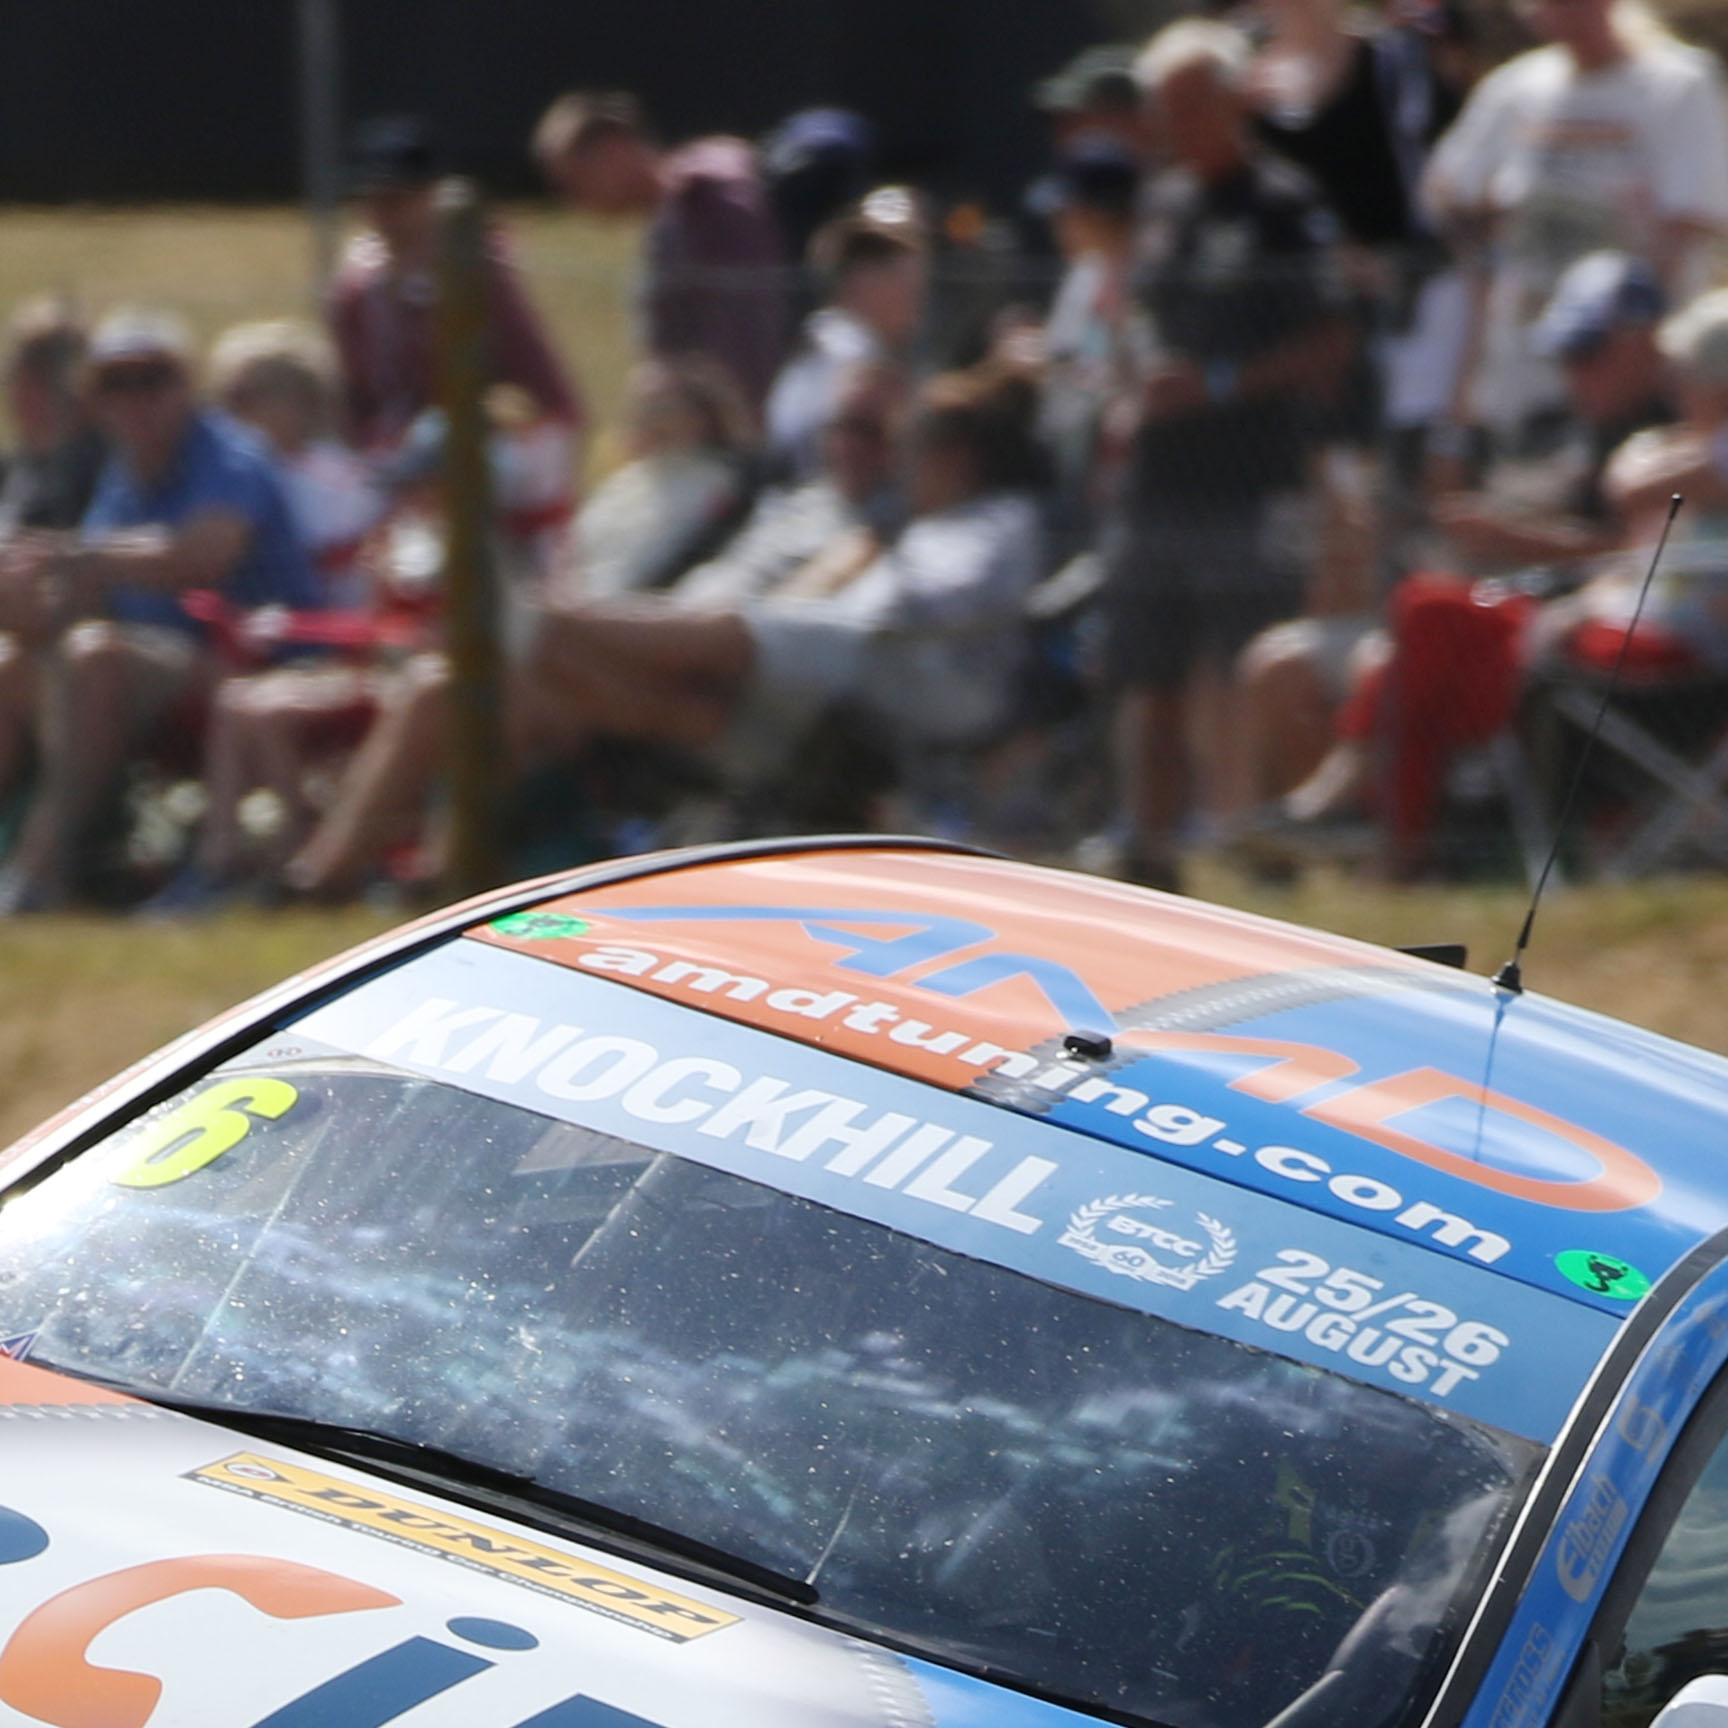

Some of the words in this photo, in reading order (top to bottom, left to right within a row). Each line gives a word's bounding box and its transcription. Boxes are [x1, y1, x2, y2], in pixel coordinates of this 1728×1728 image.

[110, 1076, 299, 1189] 6
[372, 996, 1059, 1236] KNOCKHILL
[577, 943, 1512, 1265] amdtuning.com
[1106, 1215, 1205, 1258] BTCC
[1112, 1250, 1146, 1268] 60
[1218, 1281, 1479, 1397] AUGUST
[1256, 1248, 1511, 1368] 25/26
[261, 1493, 343, 1525] British
[351, 1522, 443, 1558] Touring
[446, 1553, 485, 1574] Car
[494, 1569, 677, 1641] Championship
[296, 1487, 720, 1625] DUNLOP
